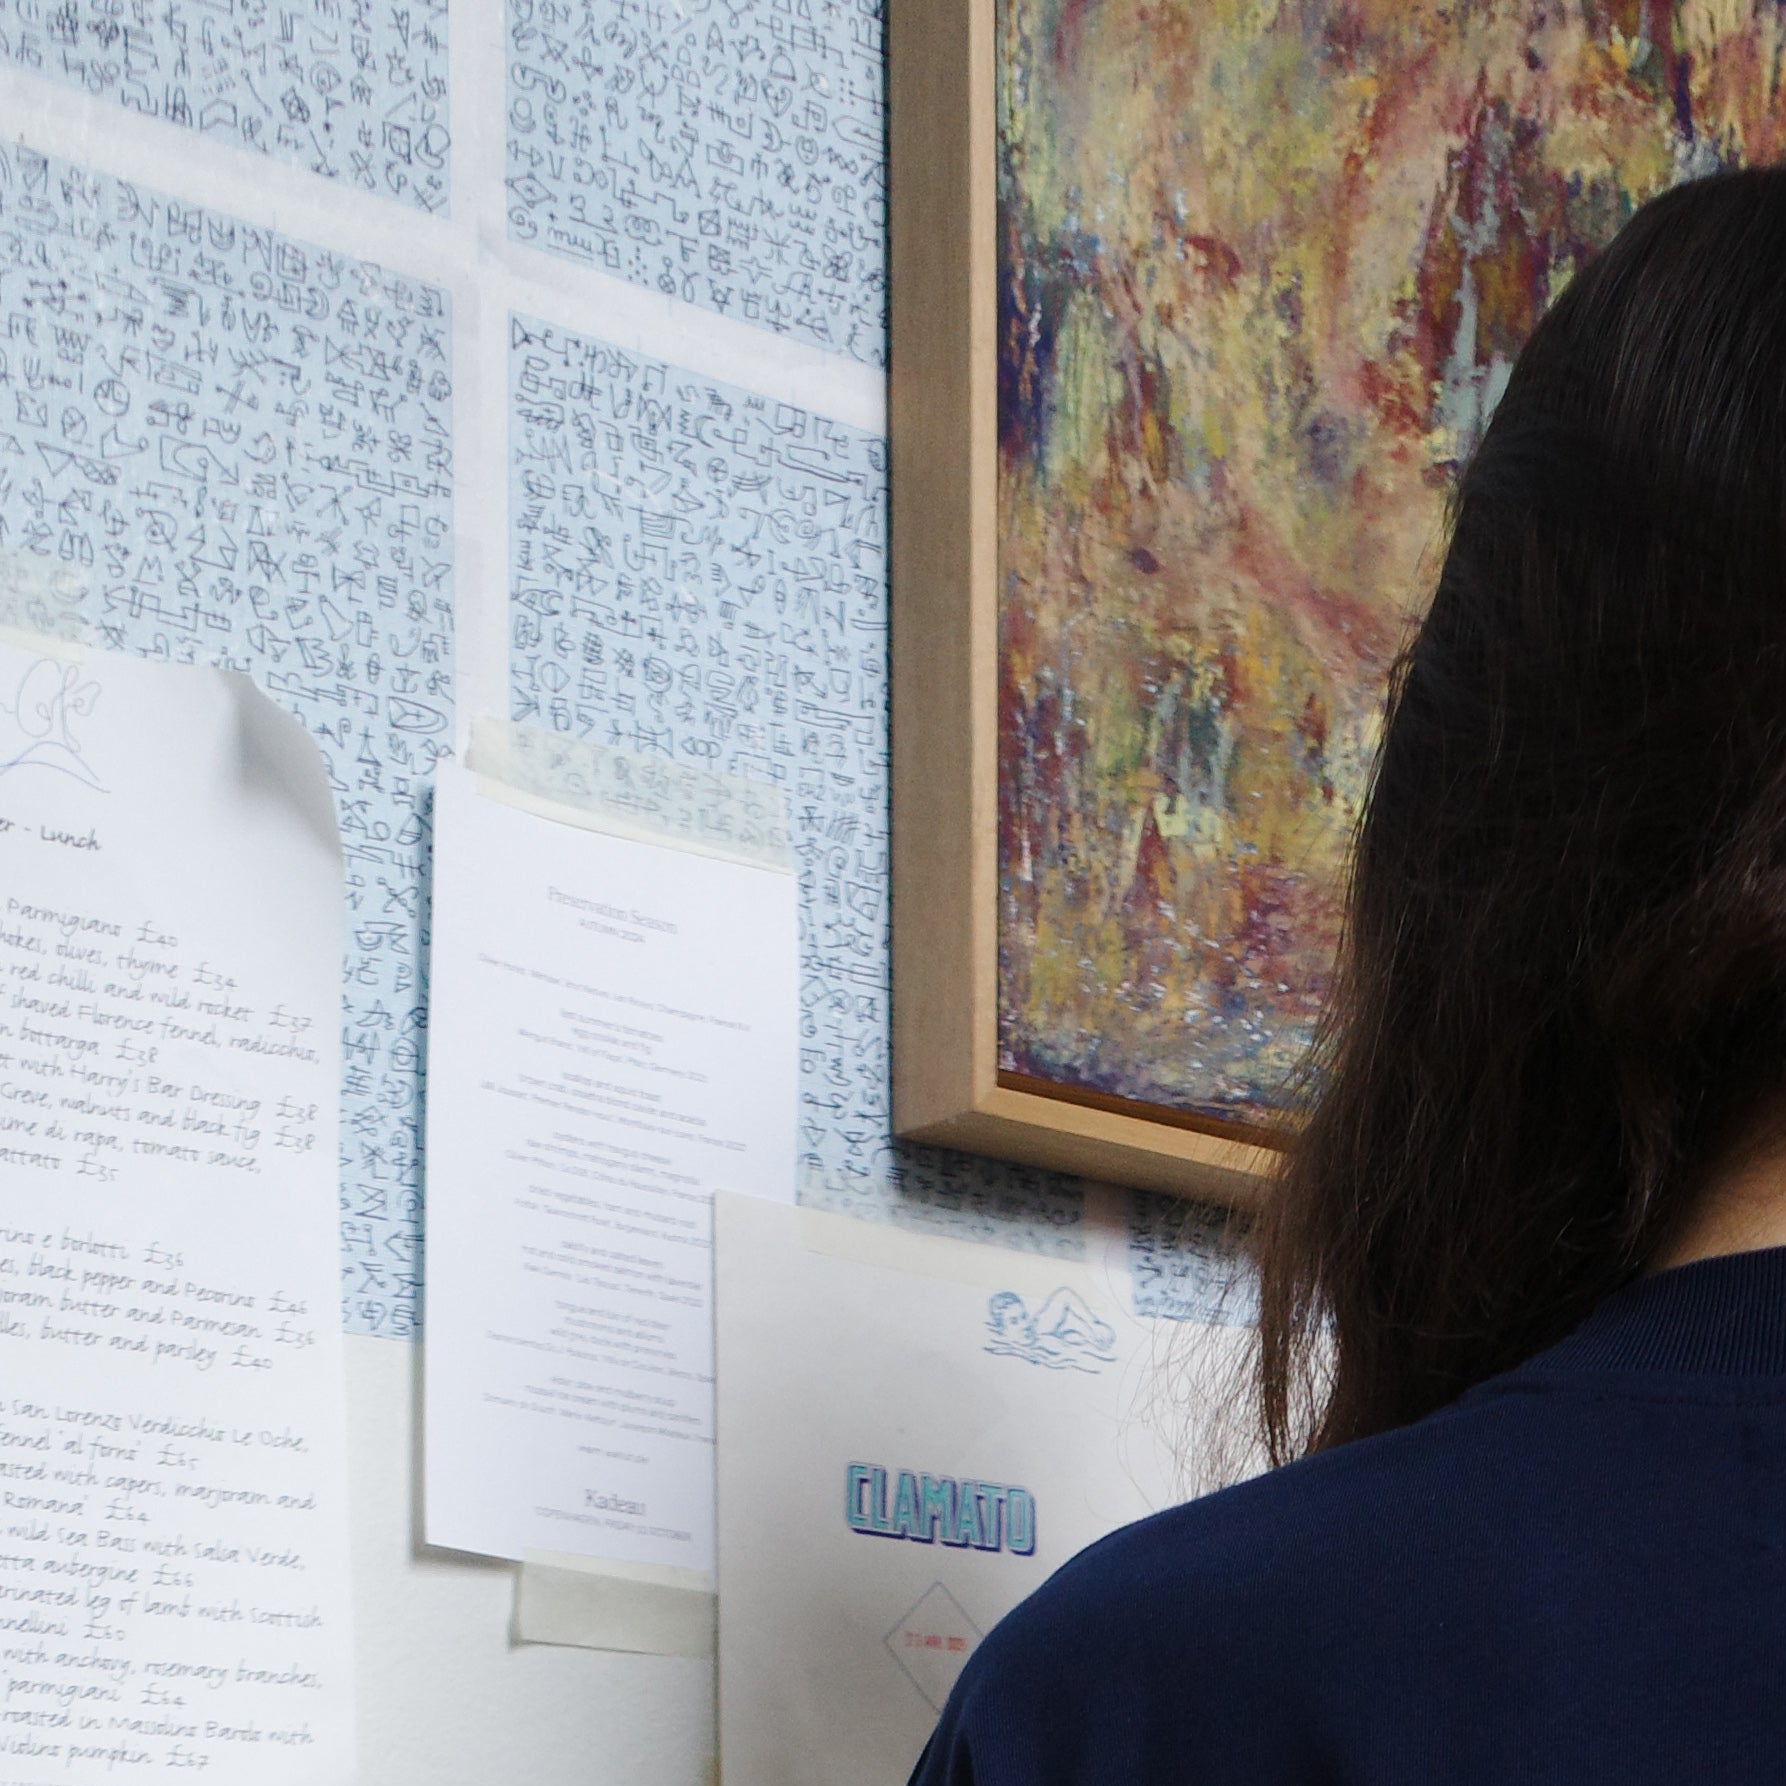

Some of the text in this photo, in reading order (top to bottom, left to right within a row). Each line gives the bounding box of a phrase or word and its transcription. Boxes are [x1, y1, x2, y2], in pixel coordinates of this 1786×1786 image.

[41, 825, 102, 851] Lunch
[7, 898, 121, 937] Parmigiano
[116, 947, 178, 981] thyme
[10, 962, 41, 981] red
[48, 964, 96, 993] chilli
[104, 983, 145, 1001] and
[150, 987, 191, 1009] wild
[198, 996, 256, 1022] rocket
[10, 986, 72, 1018] shaved
[78, 1002, 154, 1034] Florence
[159, 1016, 222, 1048] fennel,
[20, 1017, 100, 1061] bottarga
[20, 1054, 64, 1077] with
[70, 1064, 140, 1098] Harry's
[148, 1076, 183, 1098] Bar
[190, 1085, 262, 1121] Dressing
[59, 1092, 131, 1121] walnuts
[137, 1108, 176, 1128] and
[182, 1106, 230, 1137] black
[231, 1121, 261, 1151] fig
[45, 1120, 67, 1141] di
[132, 1139, 200, 1162] tomato
[207, 1152, 262, 1174] sauce,
[60, 1226, 129, 1260] borlotti
[28, 1252, 78, 1281] black
[81, 1268, 136, 1296] pepper
[141, 1278, 180, 1296] and
[185, 1282, 256, 1308] Pecorino
[60, 1287, 120, 1318] butter
[126, 1306, 166, 1325] and
[171, 1309, 263, 1338] Parmesan
[40, 1316, 103, 1346] butter
[108, 1334, 149, 1352] and
[152, 1340, 217, 1371] parsley
[13, 1399, 309, 1453] San Lorenzo Verdicchio Le Oche,
[54, 1460, 99, 1486] with
[175, 1483, 272, 1508] marjoram
[276, 1491, 317, 1510] and
[847, 1461, 1036, 1556] CLAMATO
[7, 1519, 305, 1571] wild Sea Bass with Salsa Verde,
[42, 1552, 138, 1588] aubergine
[86, 1587, 111, 1620] leg
[119, 1591, 140, 1616] of
[144, 1592, 193, 1618] lamb
[198, 1599, 243, 1621] with
[3, 1641, 48, 1665] with
[144, 1661, 228, 1690] rosemary
[235, 1658, 323, 1690] branches,
[66, 1740, 152, 1771] pumpkin
[79, 1715, 103, 1730] in
[267, 1723, 315, 1746] with
